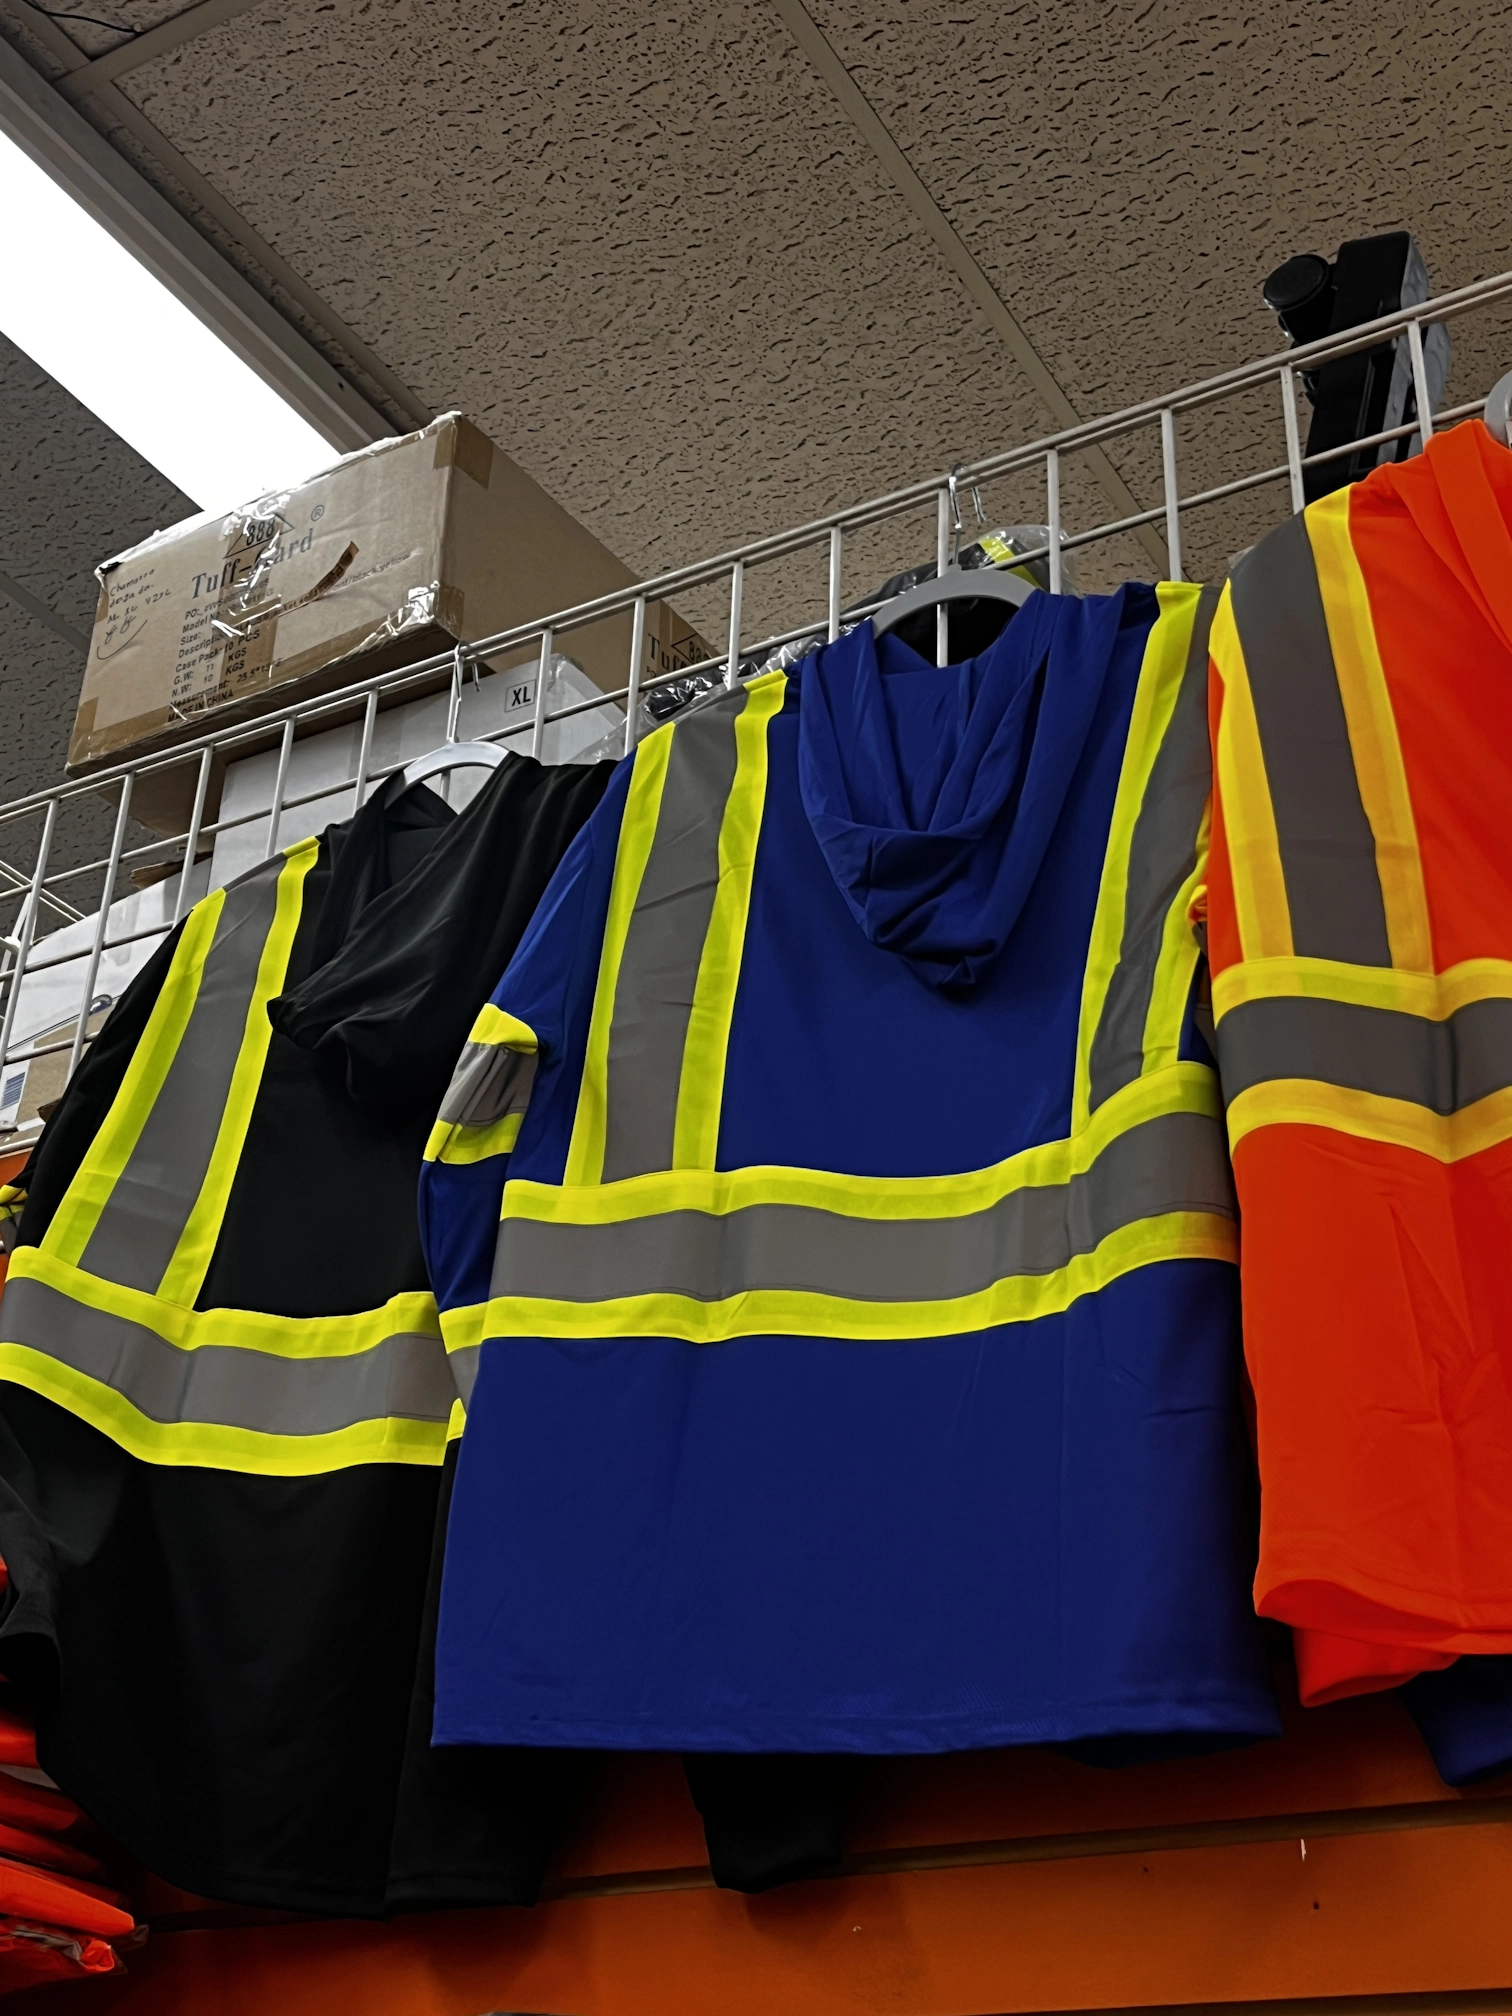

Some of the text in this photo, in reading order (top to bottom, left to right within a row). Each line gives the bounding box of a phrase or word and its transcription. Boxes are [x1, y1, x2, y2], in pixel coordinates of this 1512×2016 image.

[246, 518, 275, 546] 888
[182, 617, 208, 633] Model
[181, 632, 202, 645] Size:
[175, 660, 197, 673] Case
[238, 629, 260, 646] PCS
[227, 647, 247, 663] KGS
[225, 660, 245, 676] KGS
[206, 689, 233, 709] CHINA
[511, 686, 531, 707] XL
